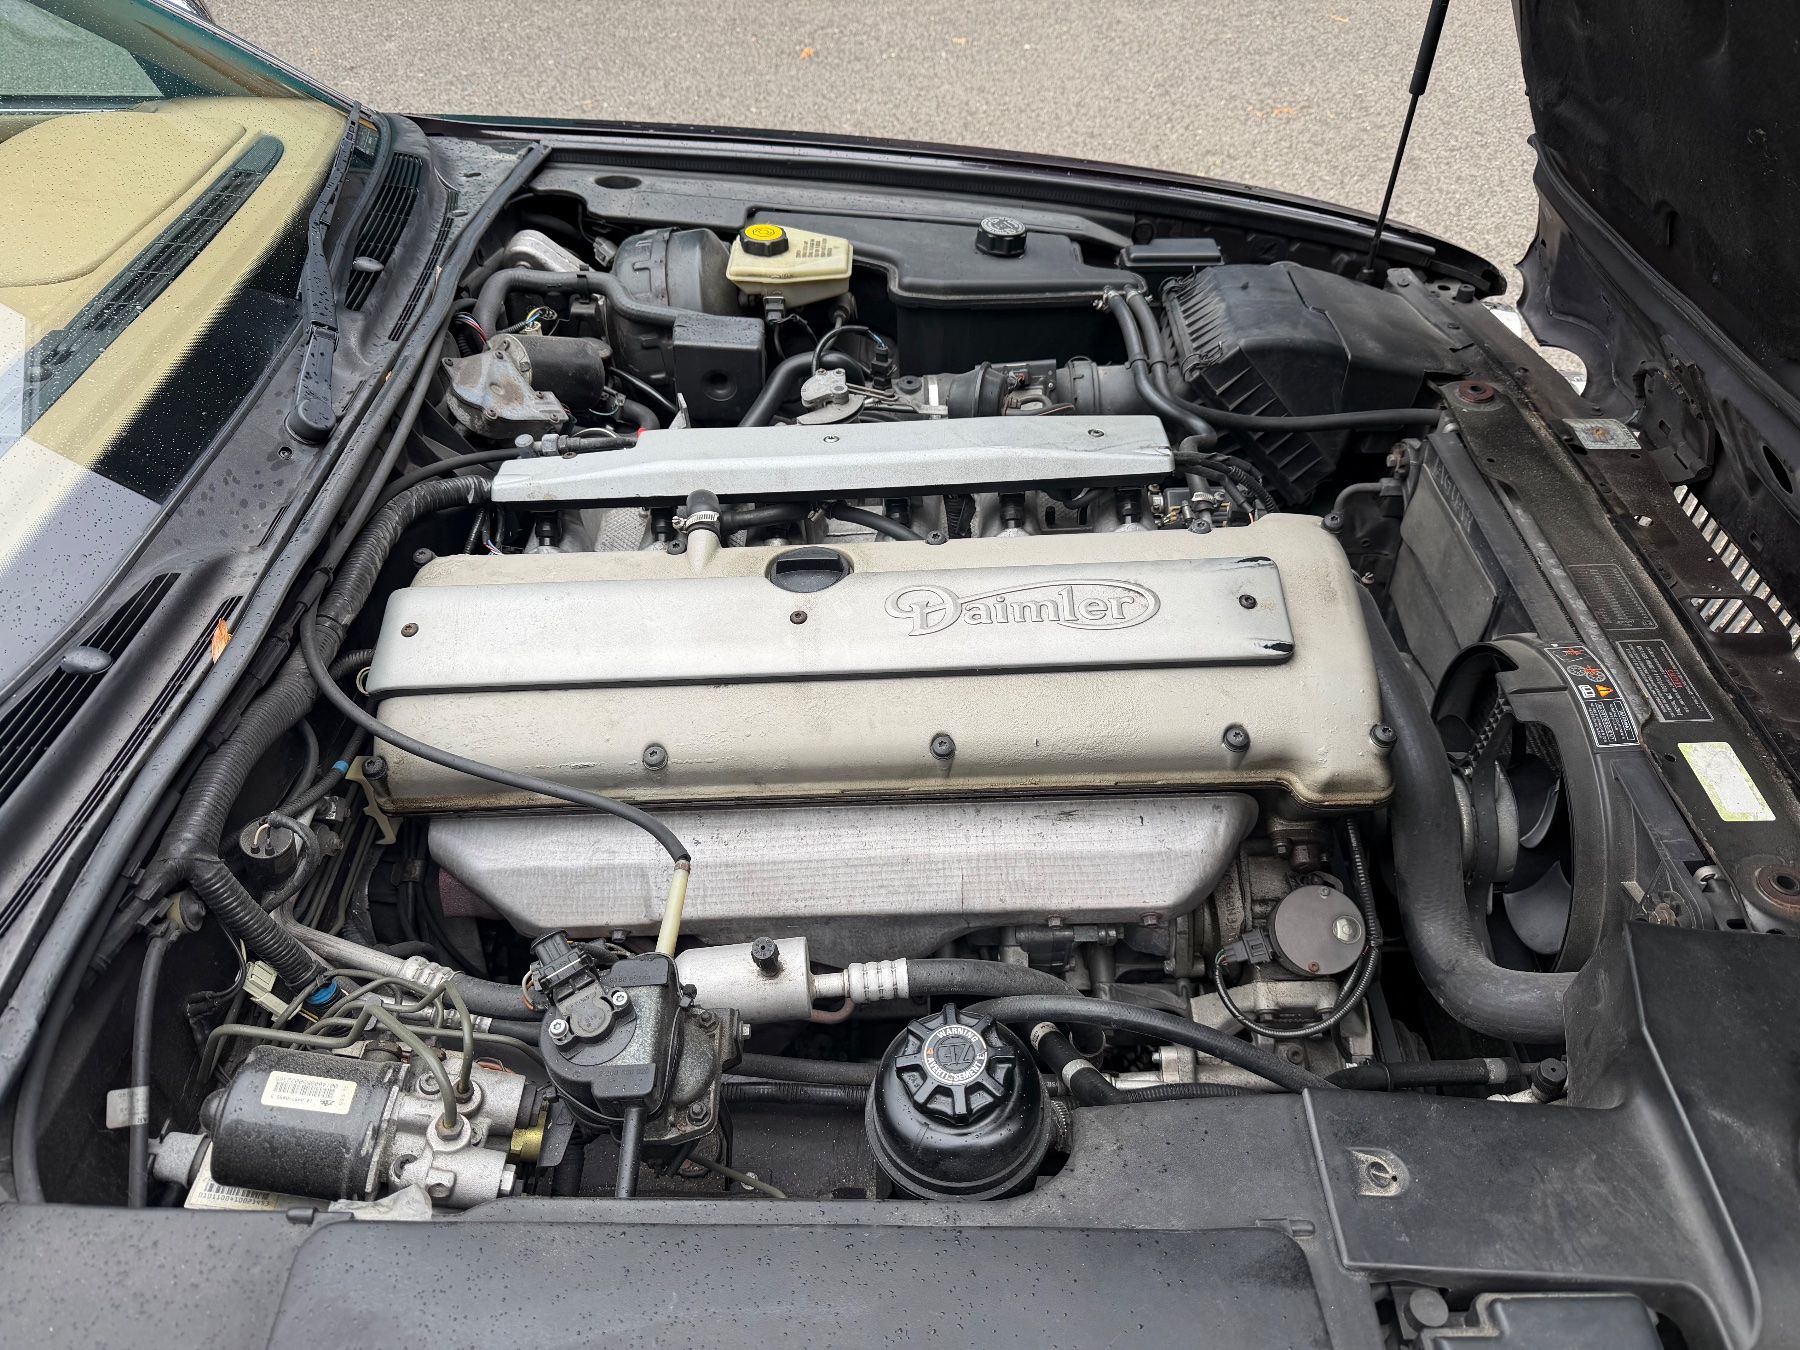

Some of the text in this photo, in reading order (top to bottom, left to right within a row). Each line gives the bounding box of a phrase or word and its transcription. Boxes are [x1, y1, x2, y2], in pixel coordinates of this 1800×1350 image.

[884, 579, 1161, 637] Daimler
[936, 1027, 979, 1043] WARNING
[927, 1057, 981, 1081] AVERTISSEMENT
